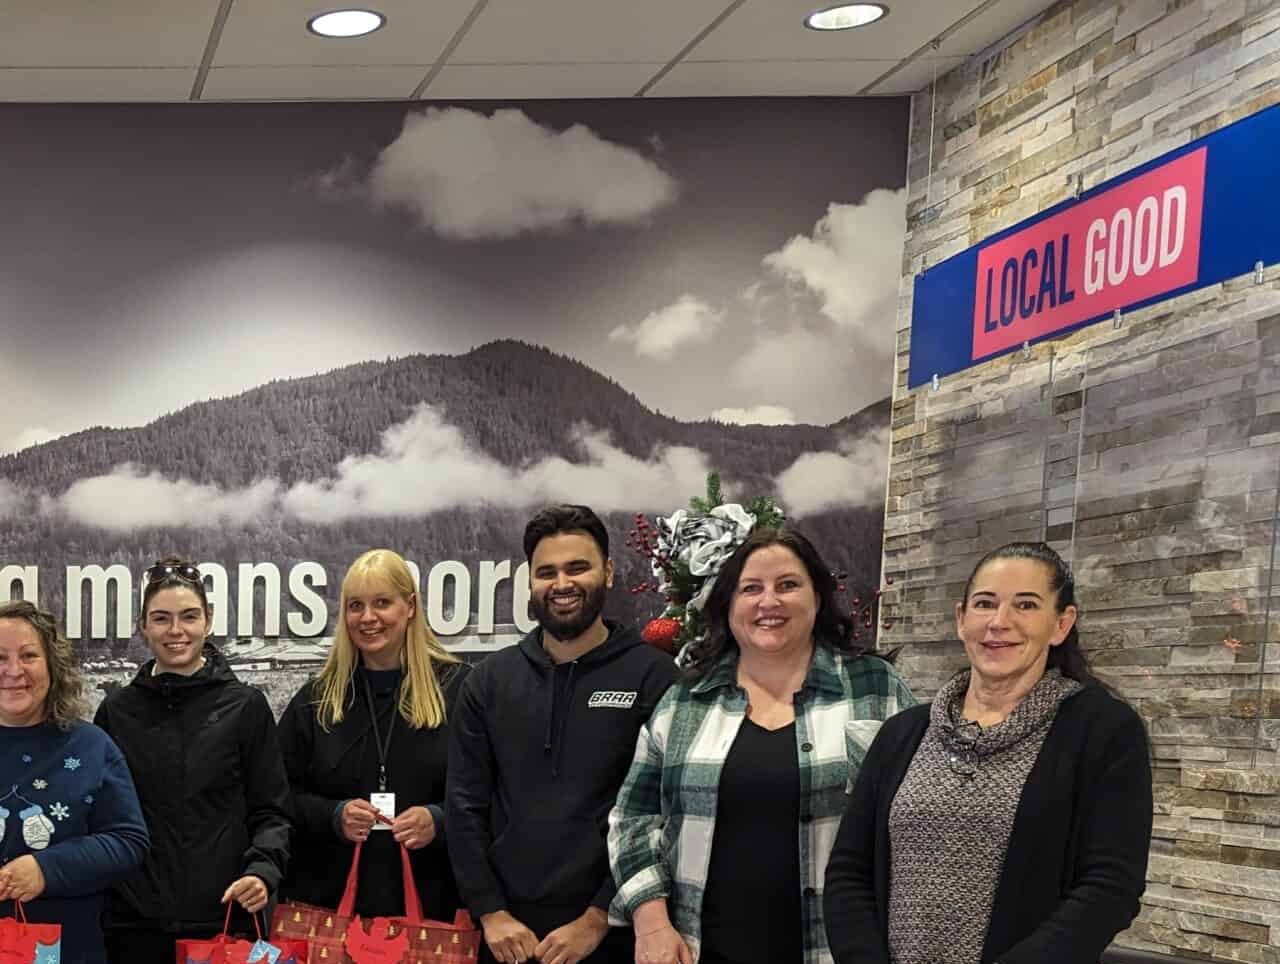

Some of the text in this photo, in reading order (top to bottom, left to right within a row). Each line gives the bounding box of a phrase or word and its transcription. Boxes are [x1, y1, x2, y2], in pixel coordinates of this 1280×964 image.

[983, 184, 1187, 334] LOCAL GOOD
[66, 561, 327, 640] mans
